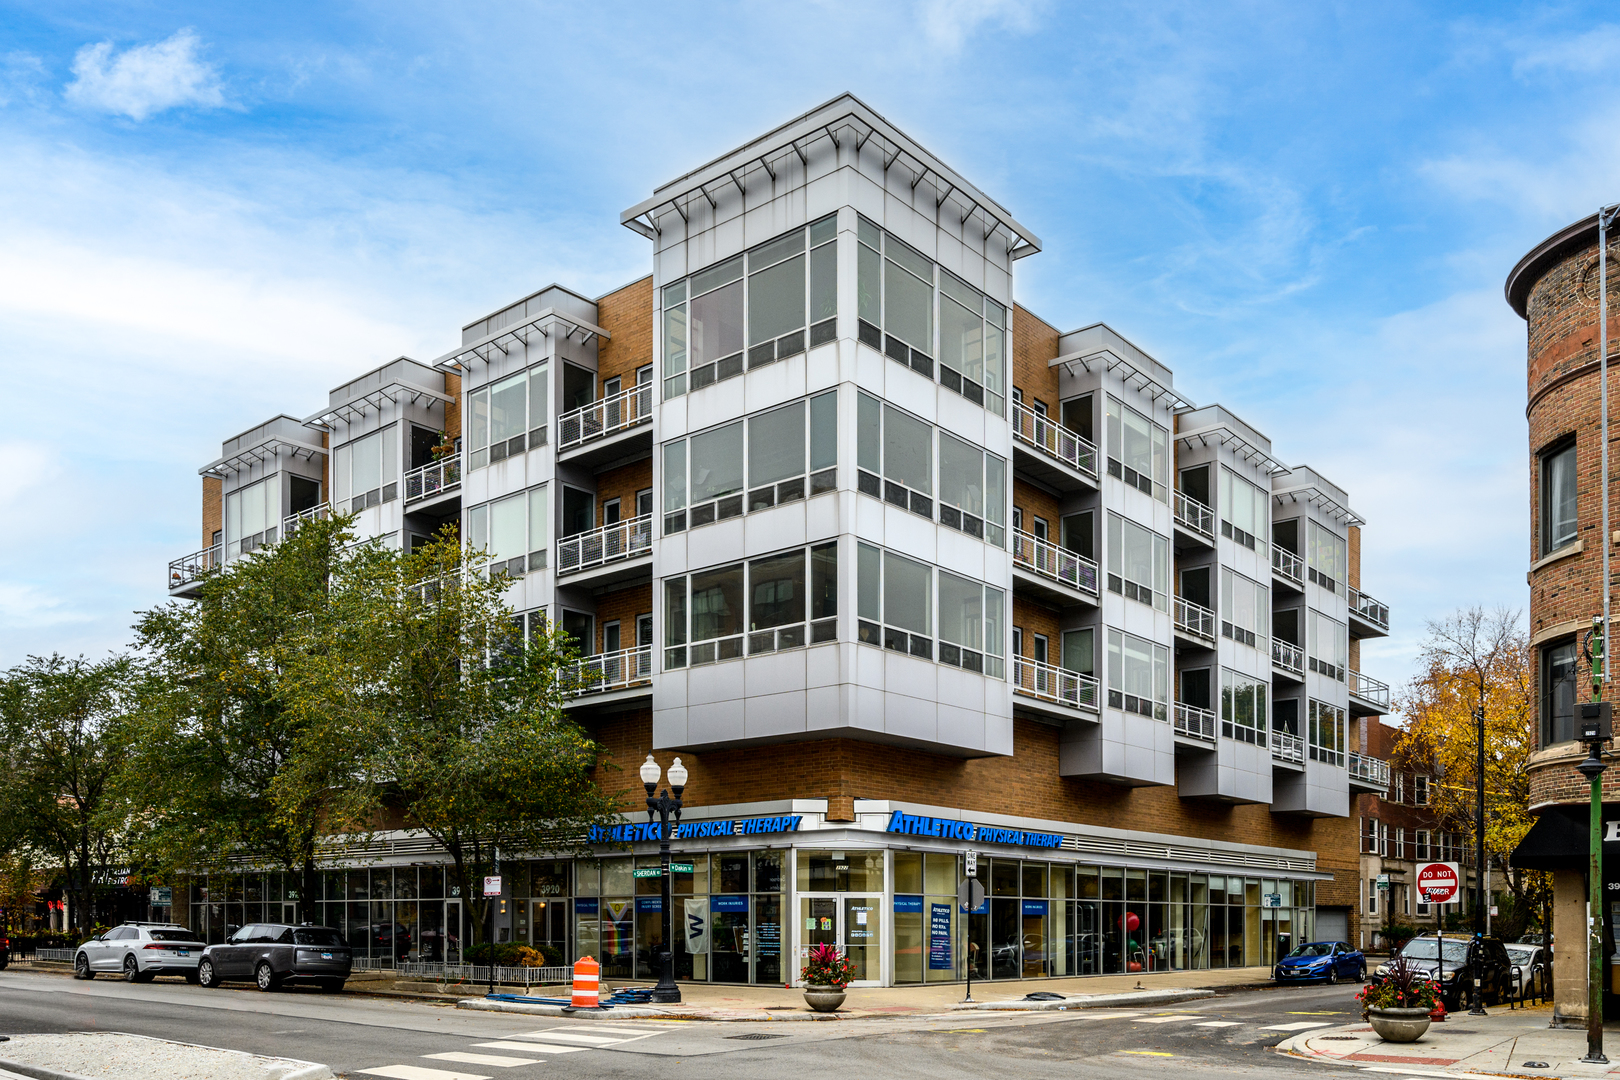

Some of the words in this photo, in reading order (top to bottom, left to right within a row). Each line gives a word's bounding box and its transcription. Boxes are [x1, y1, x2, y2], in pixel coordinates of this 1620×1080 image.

[676, 820, 735, 838] PHYSICAL
[740, 815, 802, 834] THERAPY
[887, 810, 974, 840] ATHLETICO
[976, 827, 1023, 845] PHYSICAL
[1026, 832, 1064, 848] THERAPY
[541, 884, 560, 894] 3920
[687, 913, 704, 940] W
